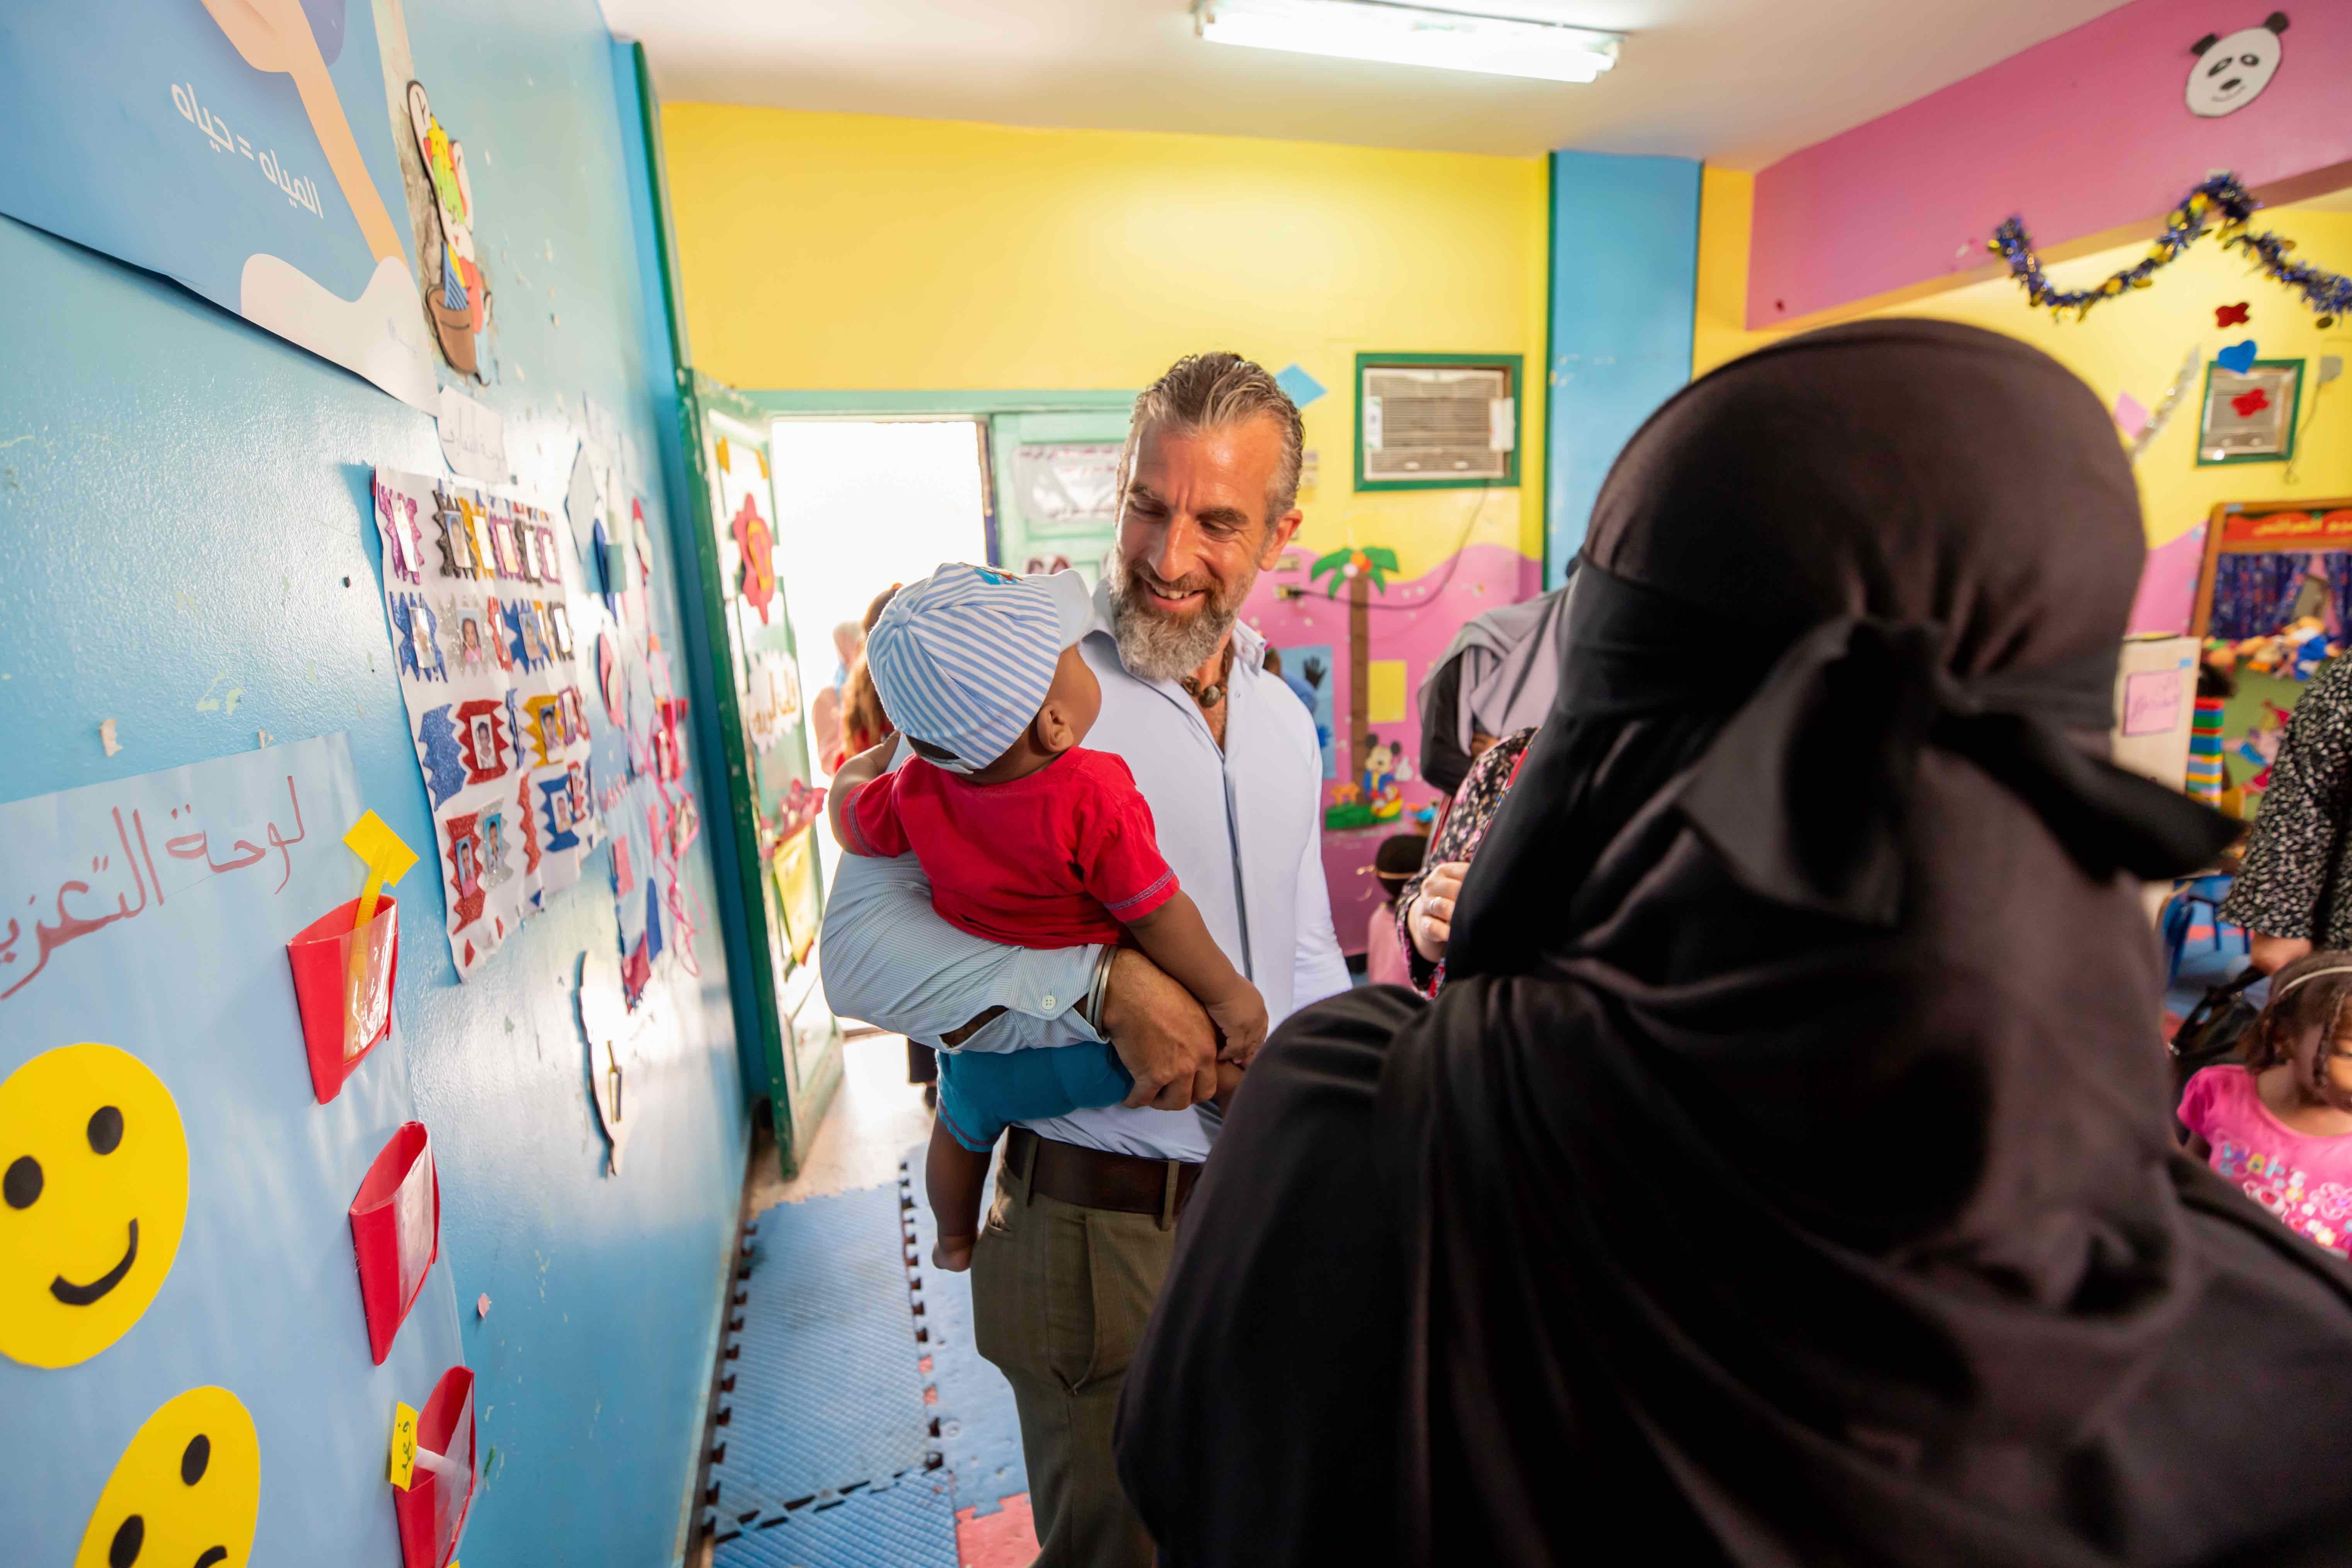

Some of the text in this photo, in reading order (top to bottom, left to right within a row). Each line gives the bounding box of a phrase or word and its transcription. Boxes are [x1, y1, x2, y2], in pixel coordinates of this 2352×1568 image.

[171, 82, 235, 154] حياه
[259, 148, 324, 220] المياه
[0, 775, 305, 1000] لوحة التعزي
